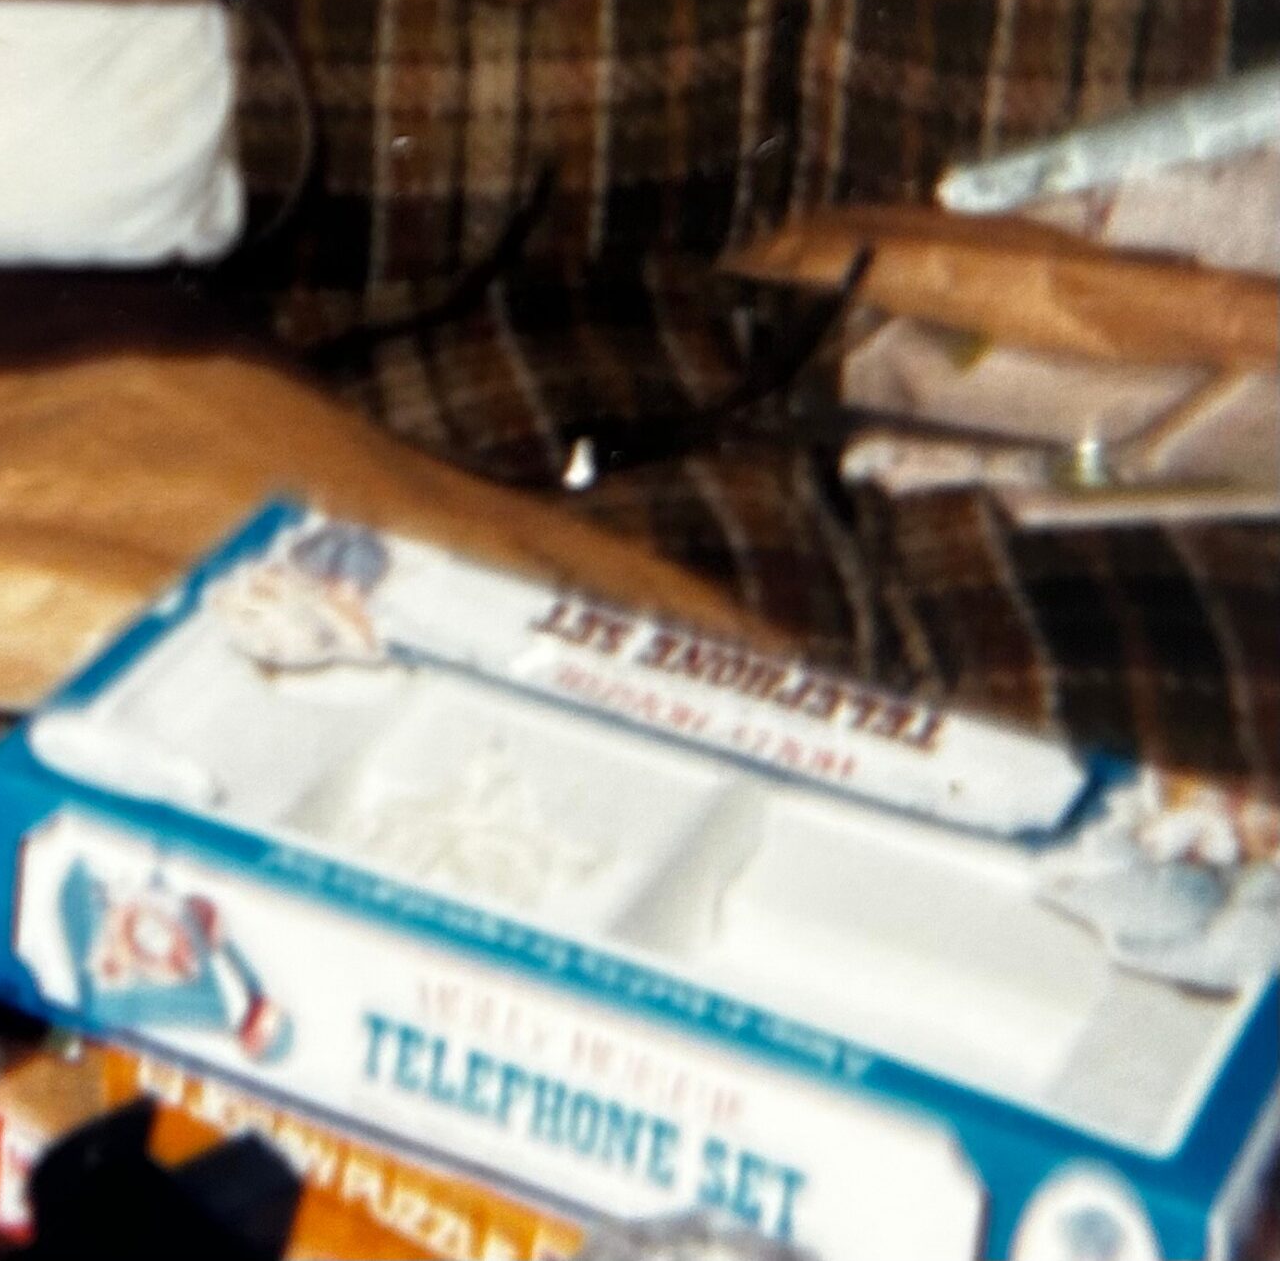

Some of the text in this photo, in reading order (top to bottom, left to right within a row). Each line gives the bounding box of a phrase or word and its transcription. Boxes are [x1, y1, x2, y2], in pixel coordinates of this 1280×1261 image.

[634, 626, 944, 753] TELEPHONE
[362, 1006, 808, 1244] TELEPHONE SET
